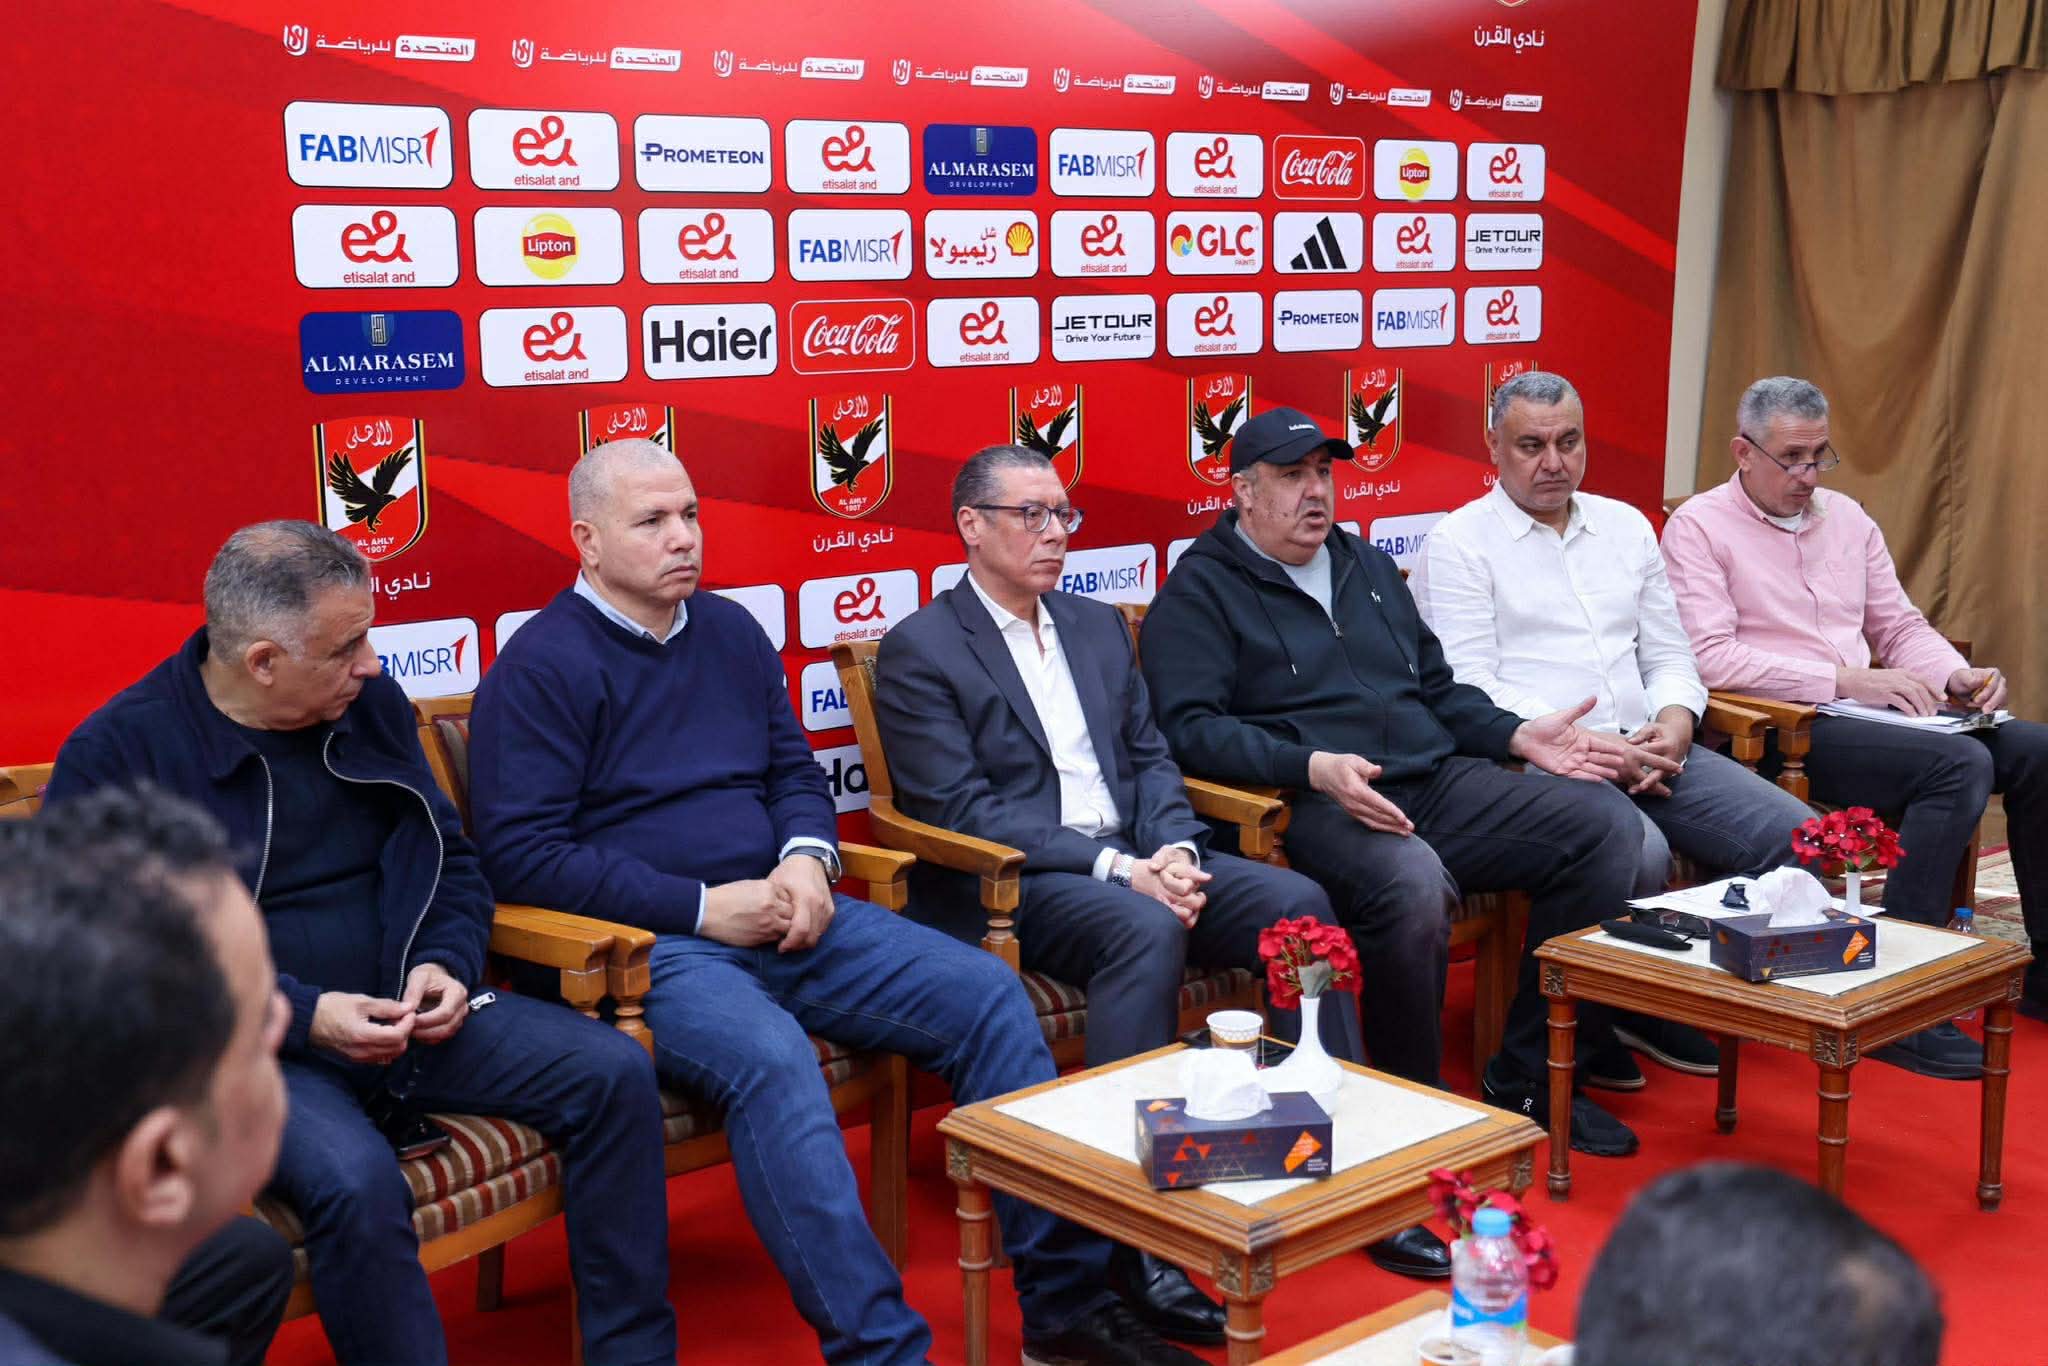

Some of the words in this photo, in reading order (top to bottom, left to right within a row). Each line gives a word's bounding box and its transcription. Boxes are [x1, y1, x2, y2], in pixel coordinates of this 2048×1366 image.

[1475, 26, 1510, 46] القرن
[1513, 30, 1544, 53] نادي
[316, 35, 391, 54] للرياضة
[400, 39, 469, 58] المتحدة
[541, 48, 607, 65] للرياضة
[615, 51, 678, 67] المتحدة
[739, 62, 798, 75] للرياضة
[803, 61, 860, 77] المتحدة
[916, 67, 969, 83] للرياضة
[974, 68, 1024, 84] المتحدة
[1074, 76, 1123, 90] للرياضة
[1127, 76, 1173, 91] المتحدة
[929, 162, 1033, 176] ALMARASEM
[1402, 166, 1428, 179] Lipton
[514, 174, 556, 185] etisalat
[558, 175, 580, 186] and
[822, 179, 857, 189] etisalat
[859, 180, 877, 190] and
[1194, 185, 1221, 194] etisalat
[1223, 185, 1237, 194] and
[1197, 224, 1255, 257] GLC
[1467, 230, 1540, 242] JETOUR
[527, 238, 571, 254] Lipton
[679, 268, 717, 279] etisalat
[719, 268, 738, 278] and
[1081, 264, 1110, 273] etisalat
[1112, 264, 1127, 272] and
[344, 271, 390, 284] etisalat
[392, 272, 415, 283] and
[1054, 314, 1152, 330] JETOUR
[651, 317, 771, 363] Haier
[1066, 335, 1088, 343] Drive
[1091, 334, 1111, 342] Your
[1113, 333, 1141, 341] Future
[1194, 344, 1221, 352] etisalat
[1223, 342, 1237, 351] and
[305, 352, 454, 372] ALMARASEM
[960, 352, 991, 362] etisalat
[992, 352, 1009, 361] and
[336, 376, 426, 385] DEVELOPMENT
[525, 369, 565, 381] etisalat
[568, 368, 589, 379] and
[1344, 482, 1373, 499] القرن
[1374, 480, 1400, 500] نادي
[1187, 495, 1220, 515] القرن
[357, 539, 369, 548] AL
[371, 536, 395, 546] AHLY
[813, 531, 856, 552] القرن
[857, 528, 893, 552] نادي
[1376, 533, 1427, 556] FABMI
[366, 545, 387, 554] 1907
[385, 572, 430, 600] نادي
[834, 629, 869, 641] etisalat
[870, 626, 887, 638] and
[377, 646, 452, 678] BMISR
